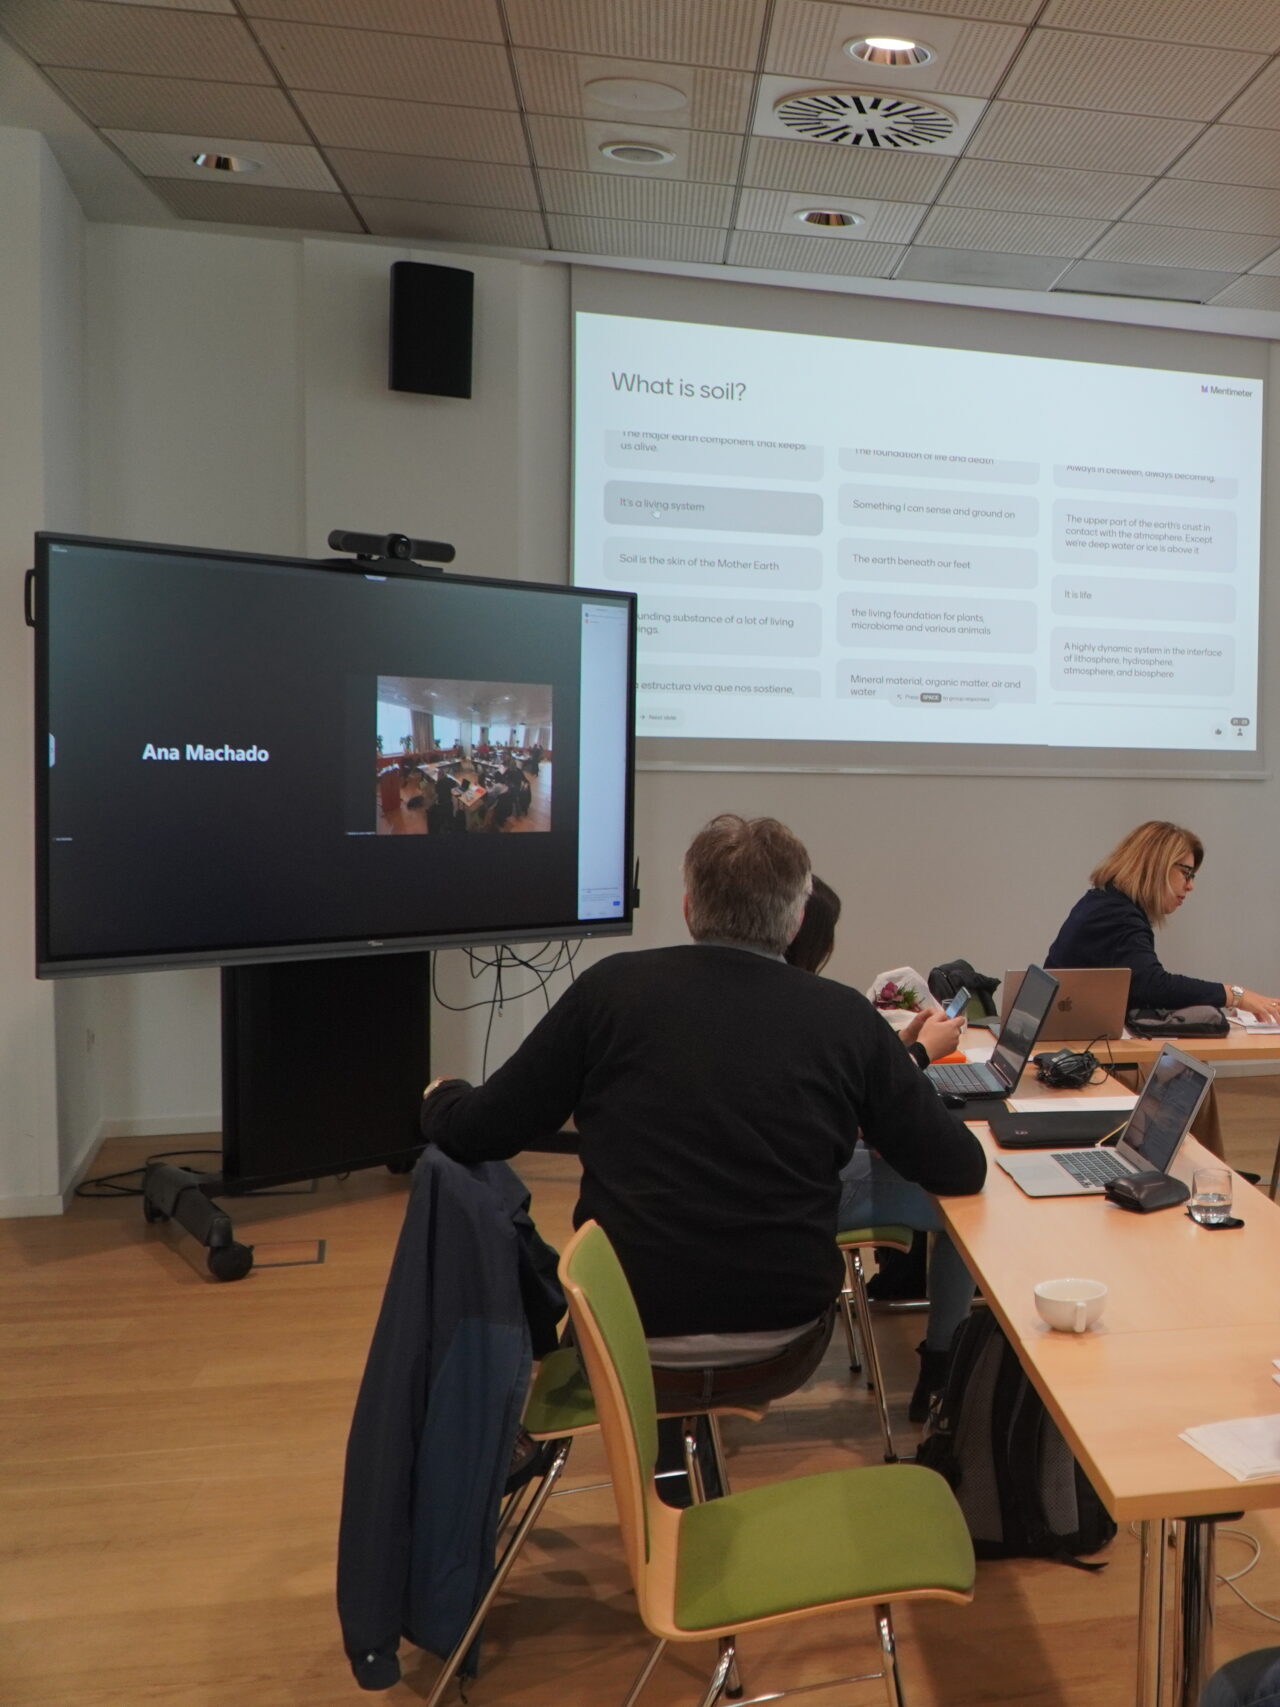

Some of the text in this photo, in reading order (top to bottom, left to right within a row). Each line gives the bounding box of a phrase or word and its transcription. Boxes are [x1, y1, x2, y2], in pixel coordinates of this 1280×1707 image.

[611, 371, 746, 401] What is soil?
[700, 435, 753, 447] component
[620, 498, 634, 507] It's
[644, 500, 669, 511] living
[671, 502, 704, 512] system
[853, 499, 901, 513] Something
[907, 505, 924, 513] can
[926, 506, 951, 514] sense
[953, 507, 970, 516] and
[972, 508, 1003, 519] ground
[1004, 511, 1015, 519] on
[1066, 514, 1082, 524] The
[1084, 517, 1108, 527] upper
[1109, 518, 1127, 528] part
[1128, 519, 1138, 527] of
[1139, 519, 1152, 528] the
[1182, 522, 1202, 531] crust
[1203, 524, 1210, 532] in
[1066, 527, 1098, 536] contact
[1100, 528, 1116, 537] with
[1118, 530, 1132, 538] the
[1185, 534, 1212, 545] Except
[1088, 540, 1110, 550] deep
[1111, 542, 1134, 550] water
[1146, 544, 1158, 552] ice
[1167, 545, 1192, 554] above
[619, 554, 779, 571] Soil is the skin of the Mother Earth
[852, 554, 870, 564] The
[872, 556, 896, 565] earth
[897, 557, 935, 567] beneath
[954, 560, 971, 569] feet
[1064, 590, 1092, 600] It is life
[637, 611, 671, 624] unding
[673, 613, 722, 624] substance
[724, 615, 735, 625] of
[736, 617, 743, 625] a
[744, 615, 757, 625] lot
[758, 616, 769, 626] of
[770, 616, 794, 628] living
[851, 608, 866, 617] the
[868, 609, 891, 620] living
[893, 610, 941, 621] foundation
[943, 612, 955, 621] for
[851, 621, 991, 635] microbiome and various animals
[1064, 642, 1222, 657] A highly dynamic system in the interface
[1063, 654, 1072, 663] of
[1117, 668, 1133, 677] and
[1134, 669, 1174, 679] biosphere
[641, 681, 692, 691] estructura
[693, 682, 713, 692] viva
[714, 684, 732, 694] que
[734, 685, 752, 693] nos
[850, 674, 884, 684] Mineral
[886, 676, 924, 687] material,
[925, 678, 958, 688] organic
[992, 679, 1002, 688] air
[1004, 679, 1021, 689] and
[850, 688, 876, 696] water
[142, 743, 269, 762] Ana Machado
